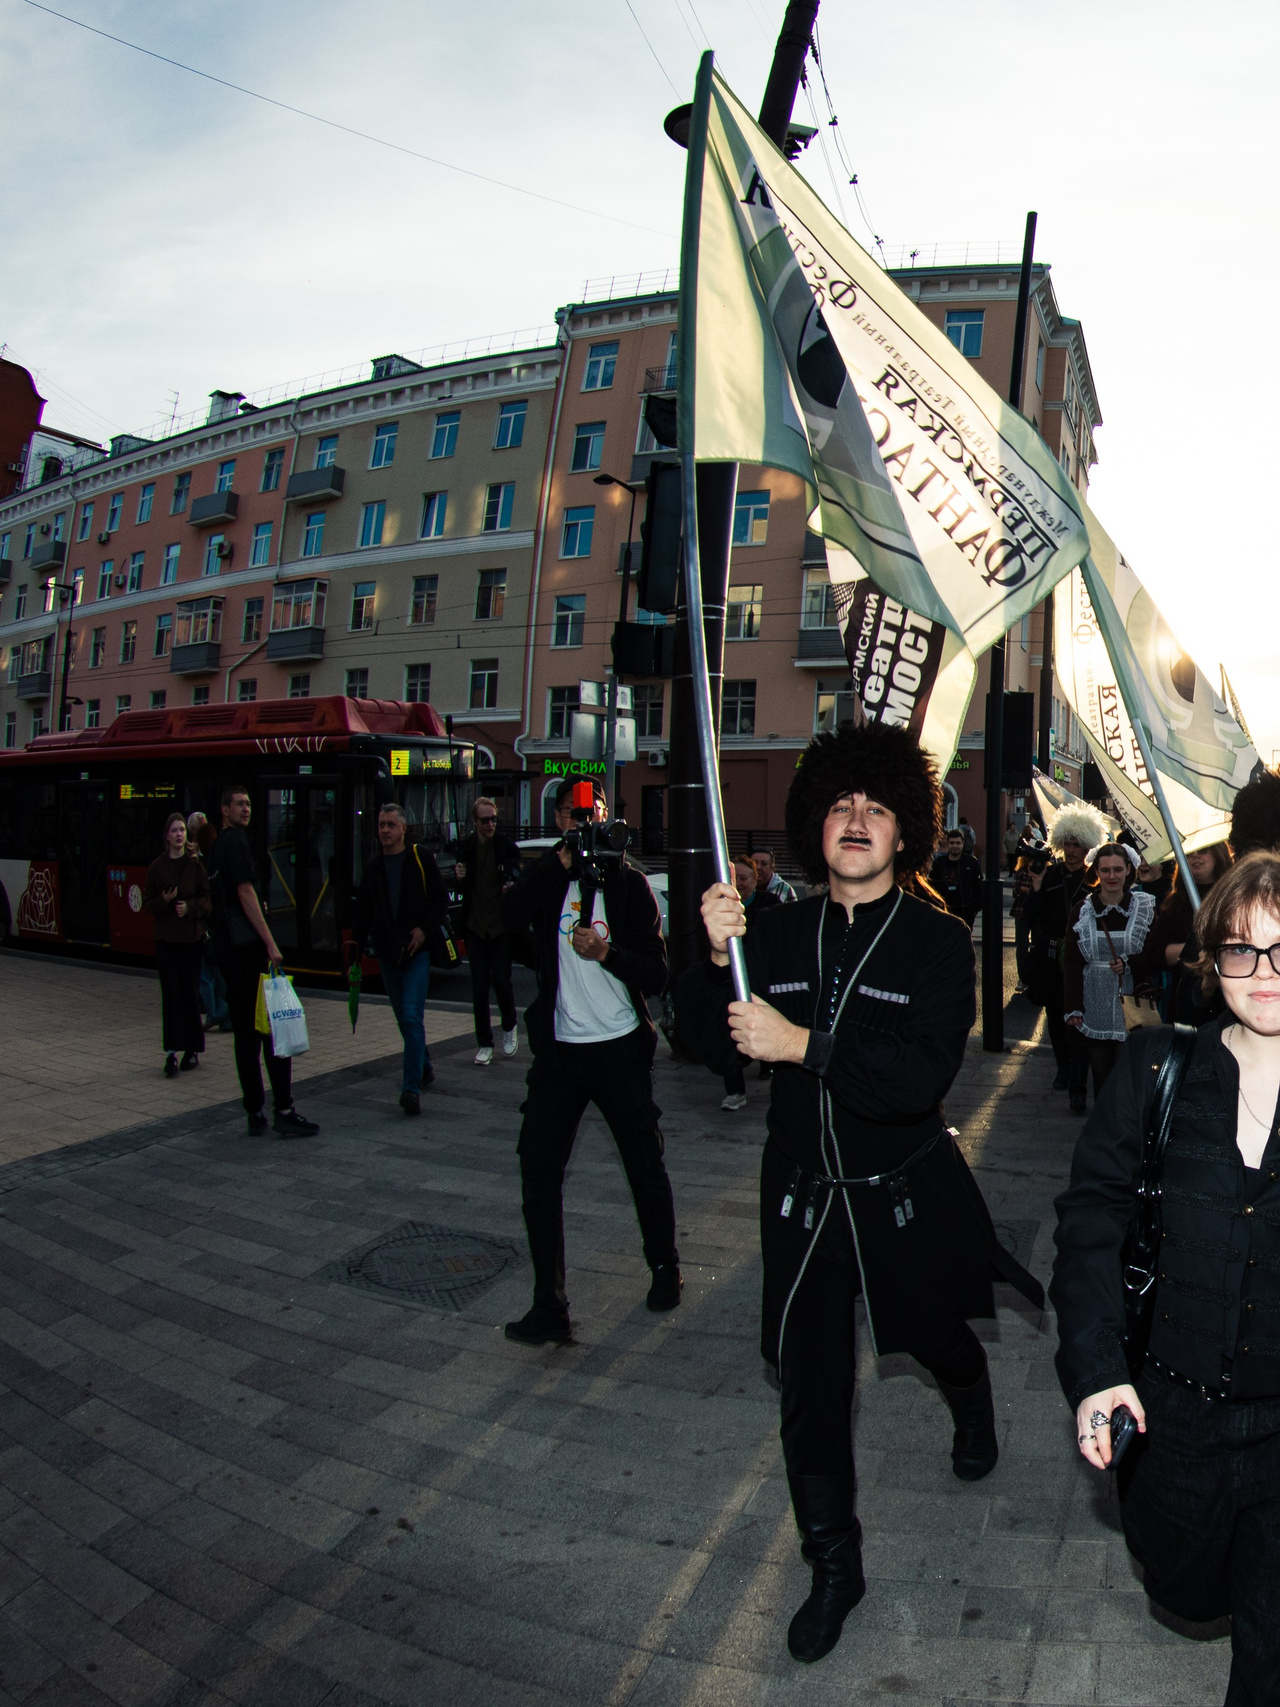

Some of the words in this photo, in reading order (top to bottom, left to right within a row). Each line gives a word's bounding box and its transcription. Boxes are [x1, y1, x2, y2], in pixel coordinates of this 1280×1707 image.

[852, 592, 880, 693] ЕРМСКИЙ
[880, 608, 933, 730] МОСТ
[395, 758, 400, 769] 2
[544, 759, 606, 777] ВкусВил
[1102, 684, 1127, 773] СКАЯ
